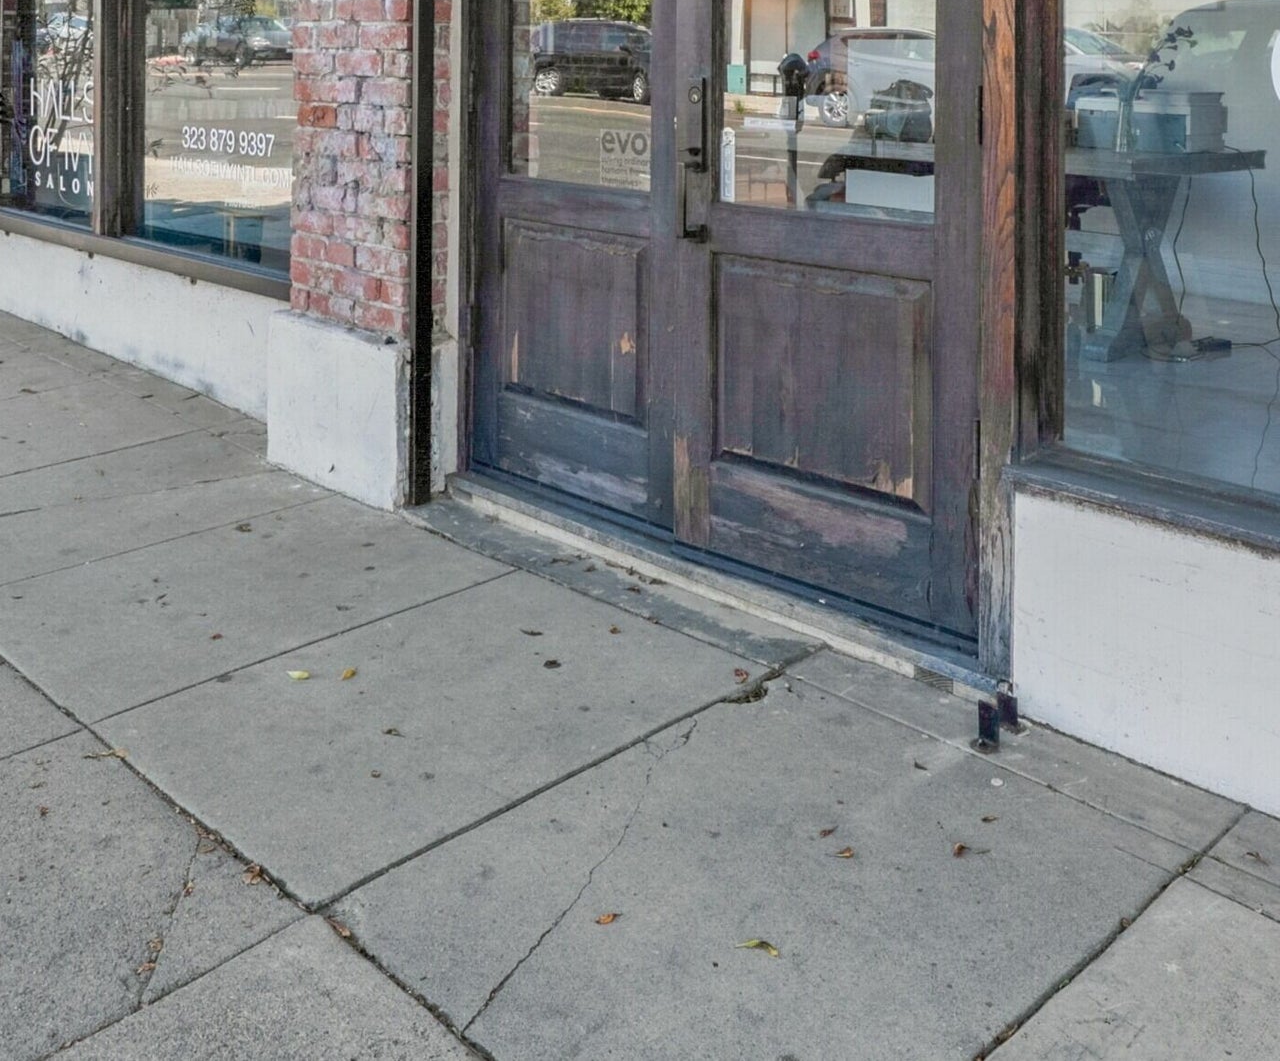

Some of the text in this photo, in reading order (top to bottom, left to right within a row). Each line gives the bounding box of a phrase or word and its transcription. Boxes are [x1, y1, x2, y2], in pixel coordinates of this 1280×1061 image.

[29, 125, 58, 168] OF
[182, 125, 275, 157] 323 879 9397
[601, 131, 648, 156] evo
[35, 171, 94, 202] SALON
